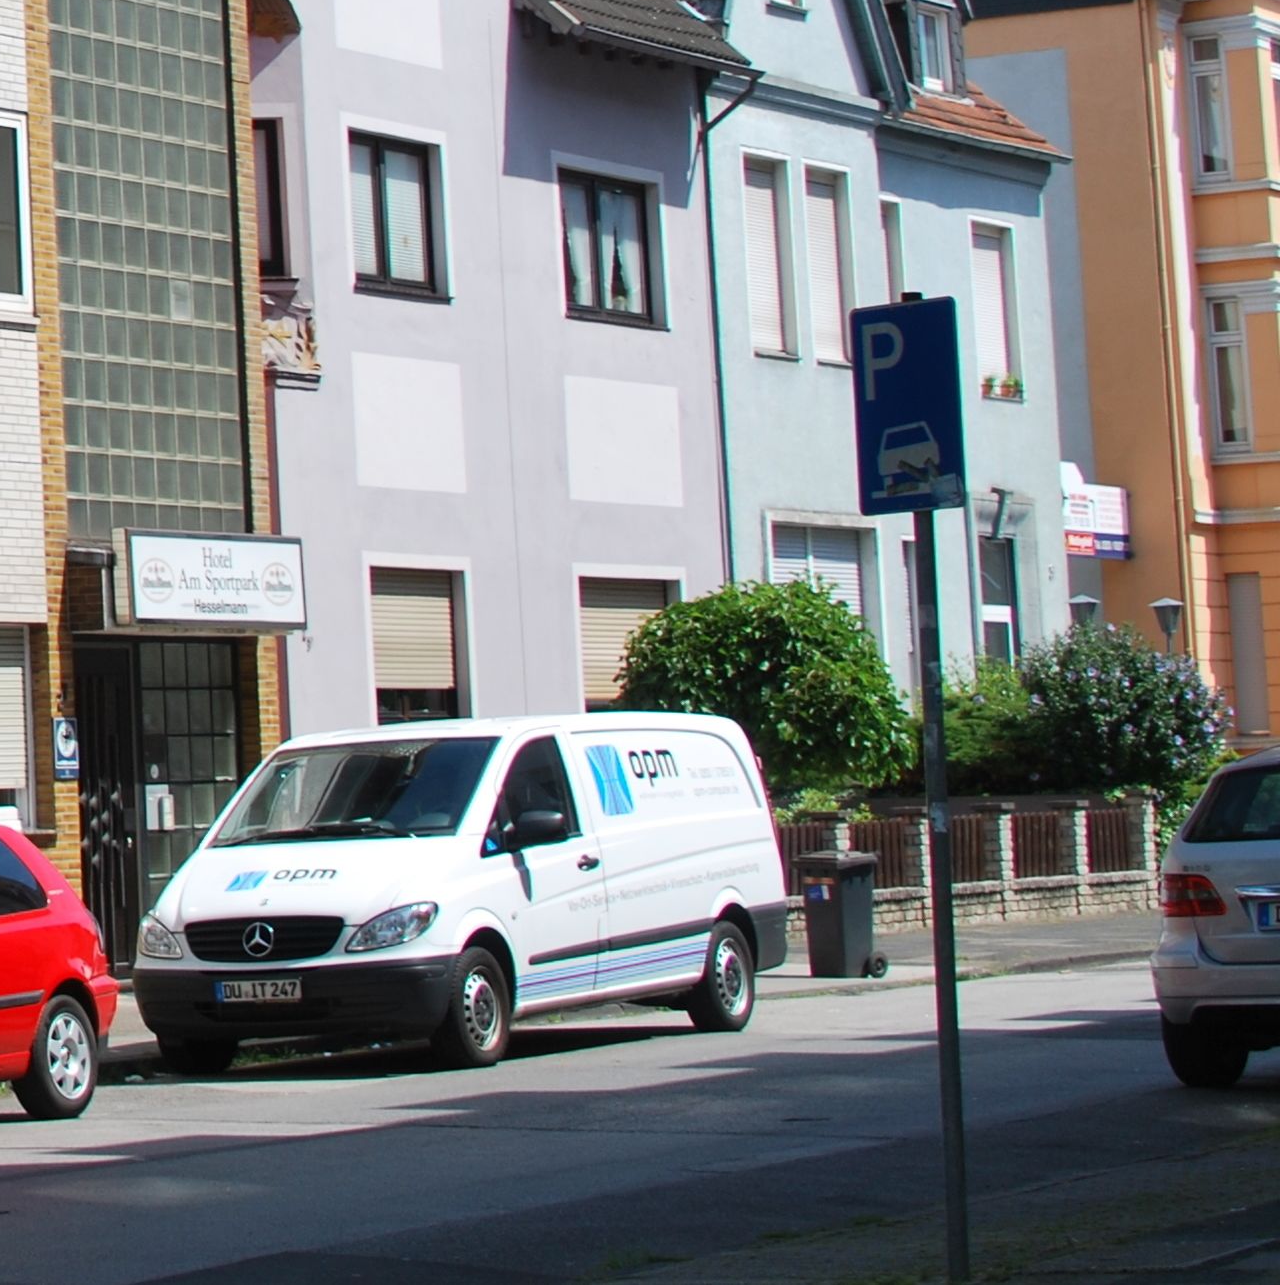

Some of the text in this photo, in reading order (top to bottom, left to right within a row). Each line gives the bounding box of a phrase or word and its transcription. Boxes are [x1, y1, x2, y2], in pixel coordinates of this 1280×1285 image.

[861, 322, 904, 401] P
[202, 547, 232, 569] Hotel
[179, 569, 201, 590] Am
[206, 570, 260, 595] Sportpark
[194, 599, 248, 615] Hesselmann
[627, 748, 679, 787] opm
[273, 868, 338, 882] opm
[224, 982, 298, 999] DU IT 247
